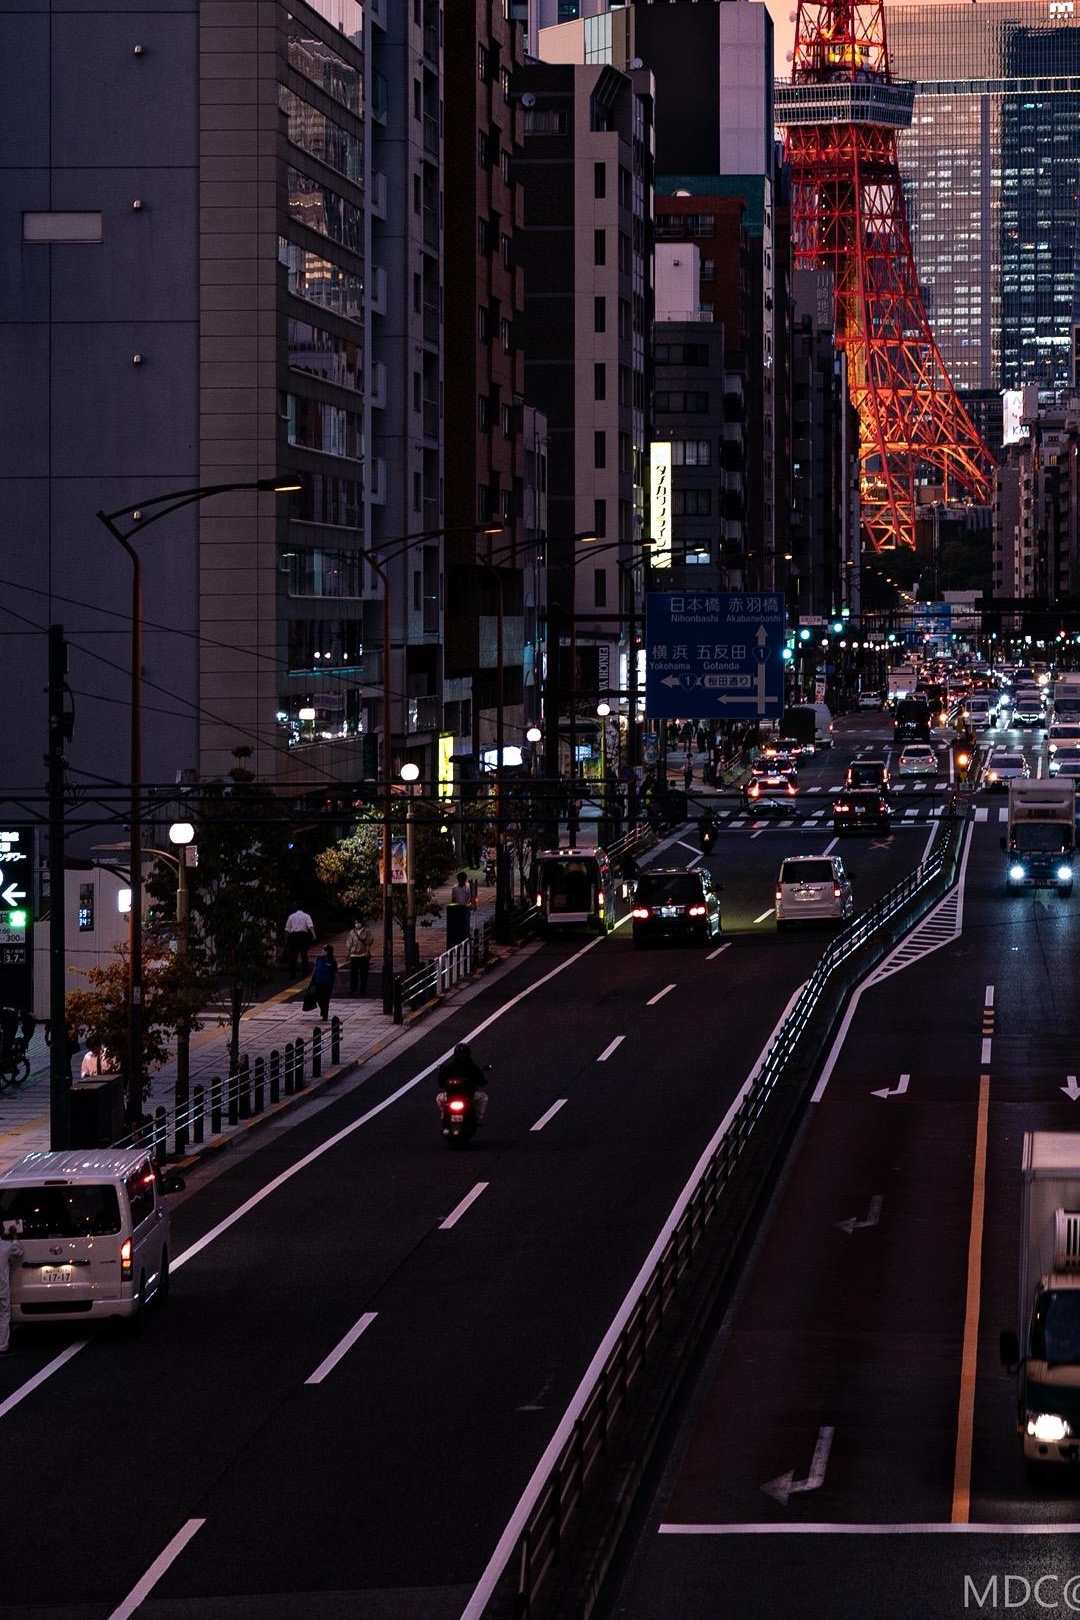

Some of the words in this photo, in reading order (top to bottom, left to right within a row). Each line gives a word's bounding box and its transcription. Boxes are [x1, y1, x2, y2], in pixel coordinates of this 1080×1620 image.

[671, 597, 720, 612] 日本橋
[728, 597, 779, 612] 赤羽橋
[671, 614, 719, 622] Nihonbashi
[726, 614, 780, 622] Akabanebashi
[652, 645, 688, 660] 横浜
[697, 645, 746, 660] 五反田
[759, 648, 764, 658] 1
[650, 661, 691, 670] Yokohama
[703, 661, 740, 670] Gotanda
[685, 675, 690, 685] 1
[708, 676, 748, 686] 桜田通り
